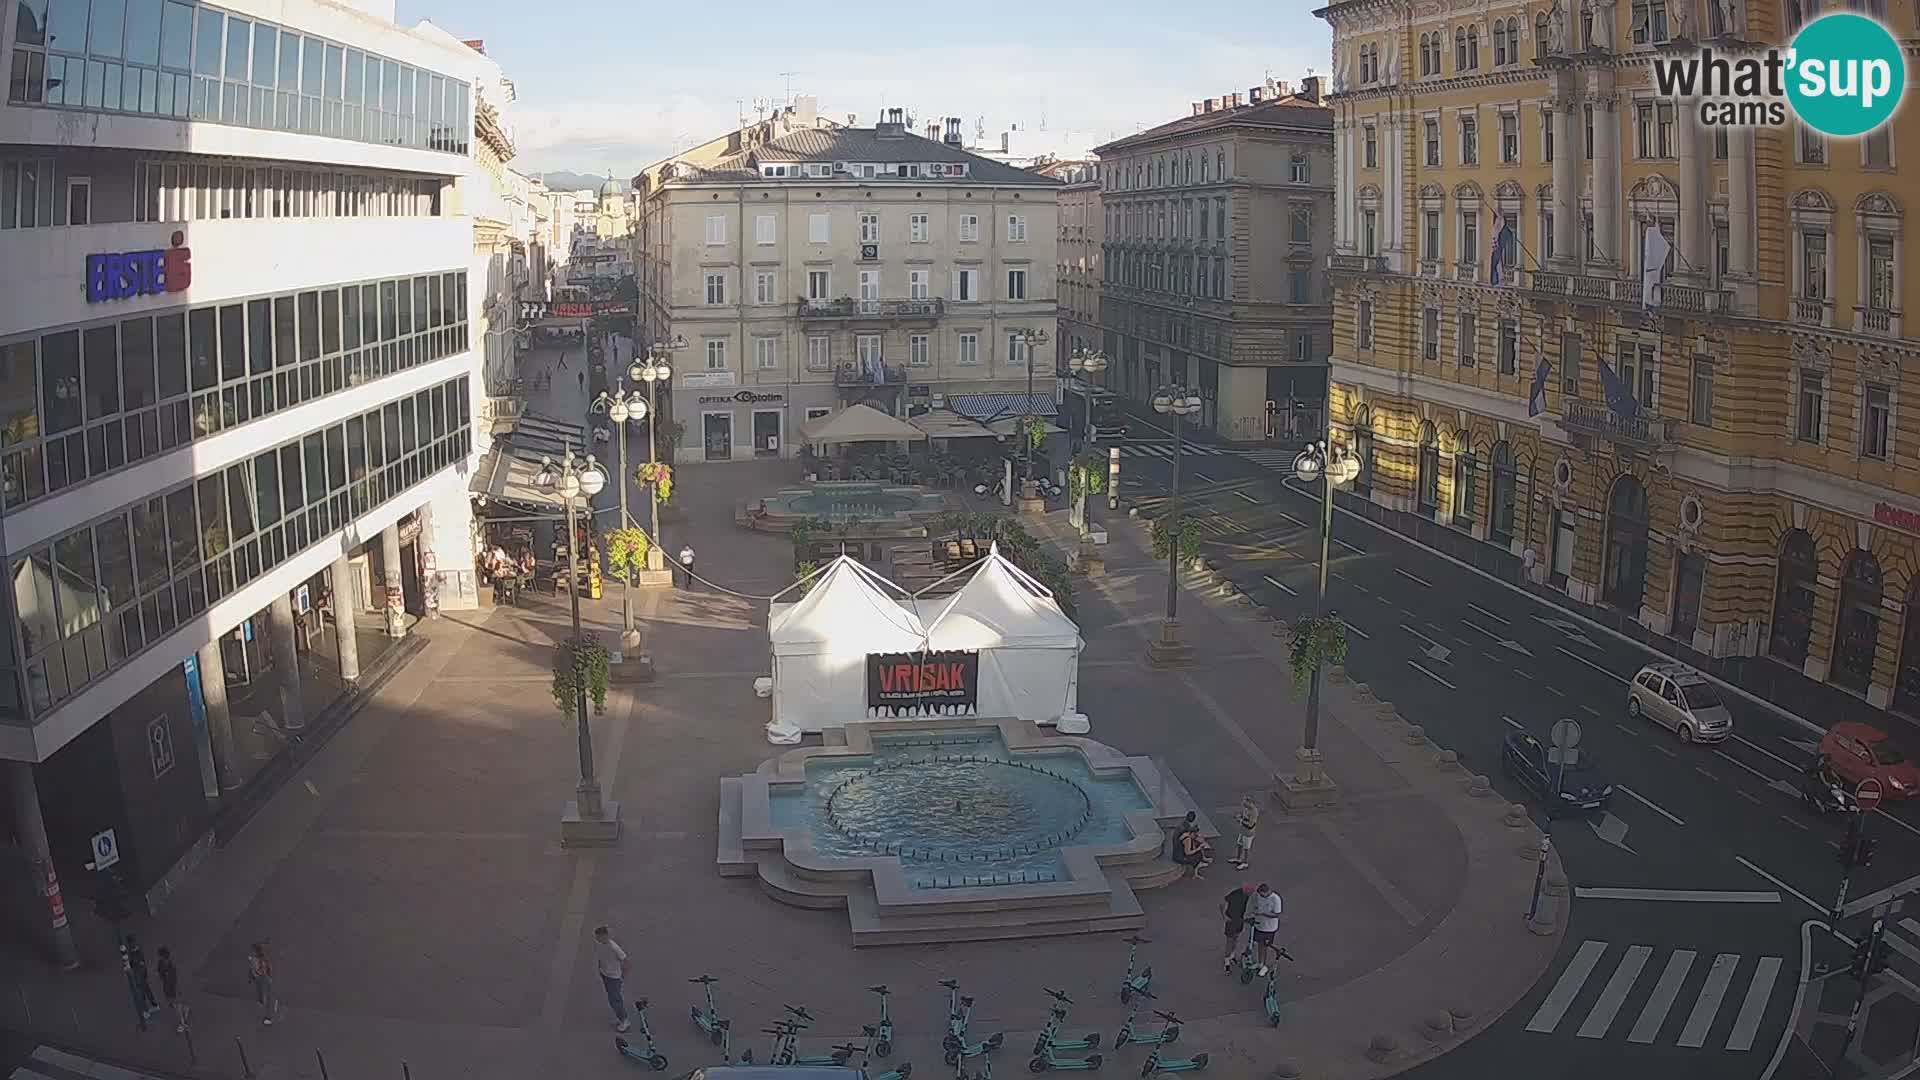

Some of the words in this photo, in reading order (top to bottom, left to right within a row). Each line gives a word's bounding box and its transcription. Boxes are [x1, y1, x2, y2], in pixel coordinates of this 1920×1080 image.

[86, 249, 166, 303] ERSTE
[698, 396, 733, 404] OPTIKA
[880, 663, 965, 692] VRISAK
